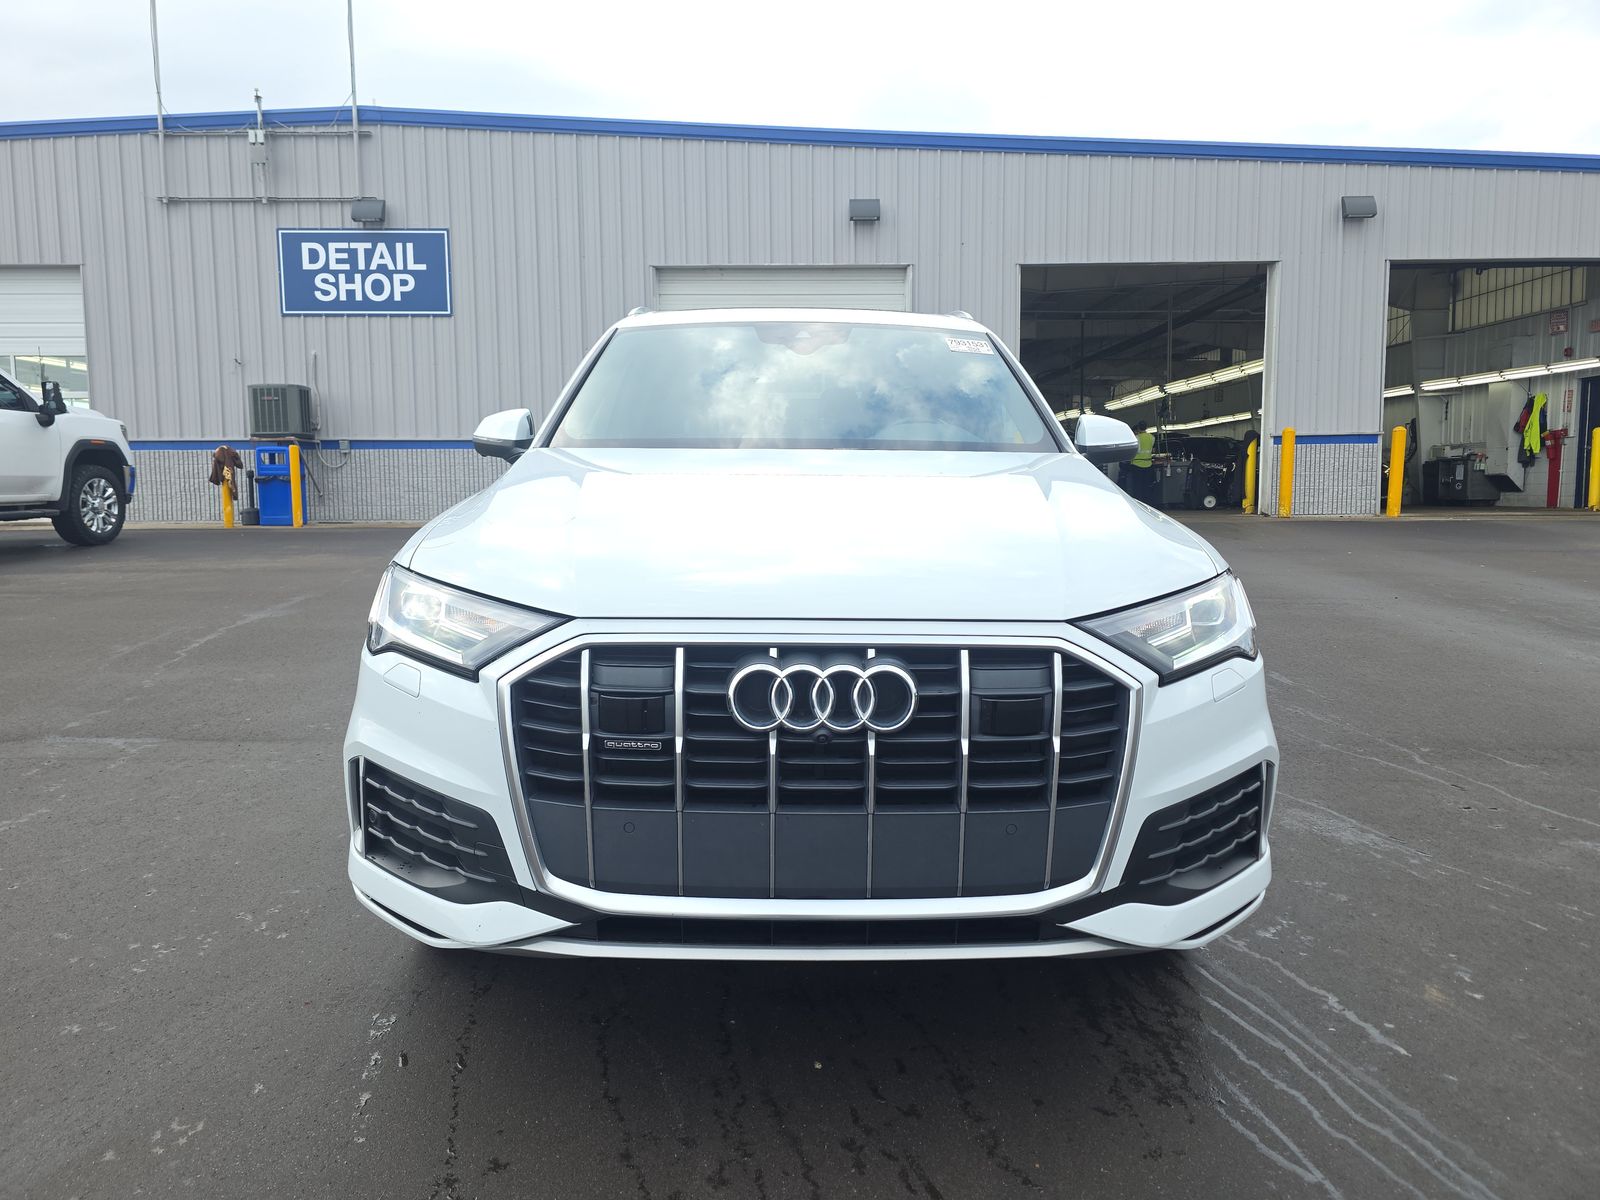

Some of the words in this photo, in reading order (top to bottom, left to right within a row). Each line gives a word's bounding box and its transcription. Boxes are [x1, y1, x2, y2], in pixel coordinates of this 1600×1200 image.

[301, 242, 427, 271] DETAIL
[314, 273, 416, 302] SHOP
[606, 741, 659, 749] quattro
